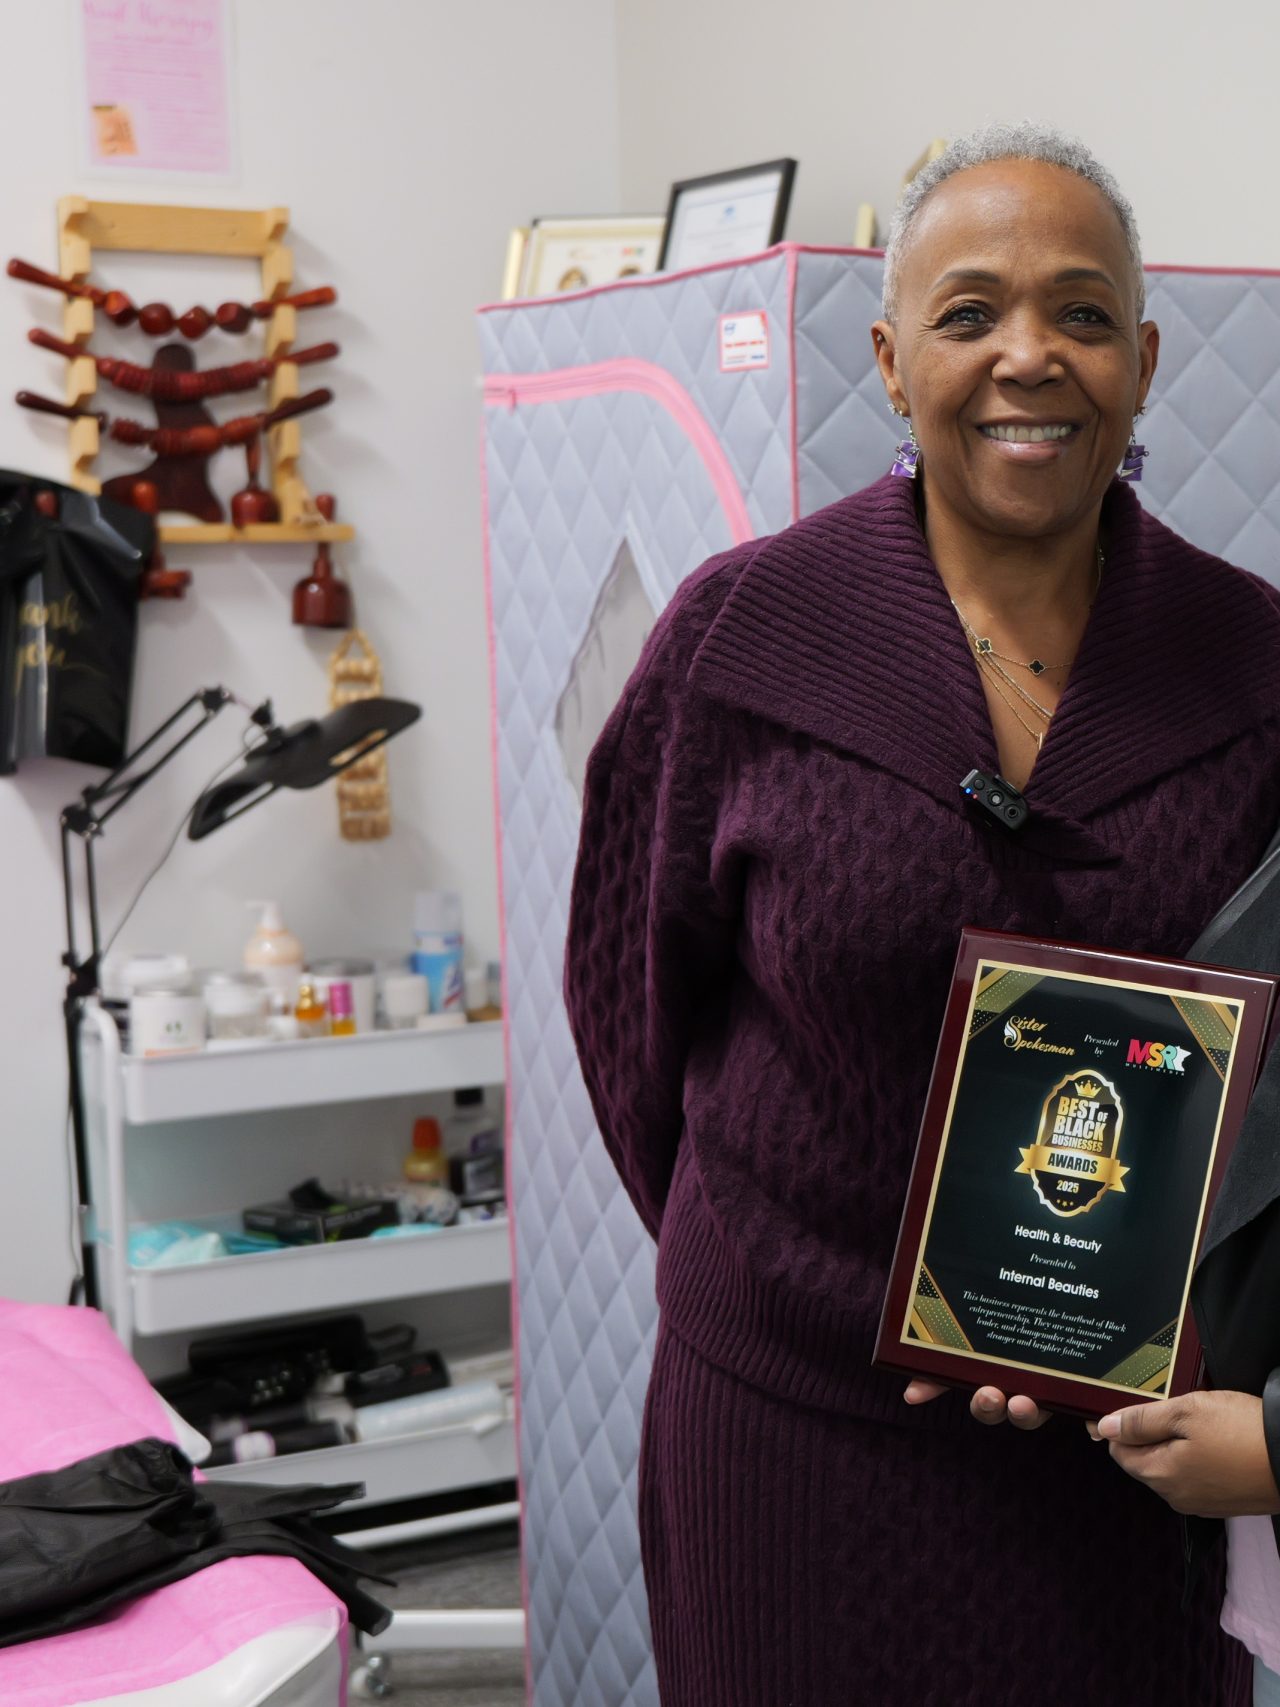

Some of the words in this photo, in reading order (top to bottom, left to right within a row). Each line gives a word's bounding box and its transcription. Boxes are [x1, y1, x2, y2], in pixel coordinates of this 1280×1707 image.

[1004, 1034, 1076, 1056] Spokesman
[1084, 1034, 1119, 1047] Presented
[1094, 1047, 1104, 1057] by
[1057, 1096, 1100, 1120] BEST
[1097, 1111, 1109, 1122] OF
[1053, 1115, 1107, 1141] BLACK
[1051, 1133, 1103, 1152] BUSINESSES
[1047, 1153, 1099, 1174] AWARDS
[1056, 1180, 1080, 1193] 2025
[1014, 1224, 1050, 1242] Health
[1052, 1232, 1061, 1244] &
[1063, 1234, 1102, 1254] Beauty
[1029, 1253, 1068, 1270] Presented
[1068, 1262, 1077, 1270] to
[999, 1267, 1046, 1288] Internal
[1047, 1277, 1100, 1299] Beauties
[963, 1290, 979, 1301] This
[979, 1294, 1010, 1308] business
[1011, 1303, 1048, 1316] represents
[1048, 1309, 1060, 1318] the
[1060, 1311, 1095, 1326] heartbeat
[1095, 1320, 1105, 1330] of
[1104, 1320, 1126, 1333] Black
[1033, 1316, 1051, 1330] They
[986, 1331, 1016, 1345] stronger
[1016, 1338, 1033, 1347] and
[1032, 1339, 1061, 1353] brighter
[1060, 1346, 1087, 1359] future.
[1001, 1324, 1017, 1332] and
[1016, 1325, 1065, 1342] changemaker
[1065, 1336, 1096, 1351] shaping
